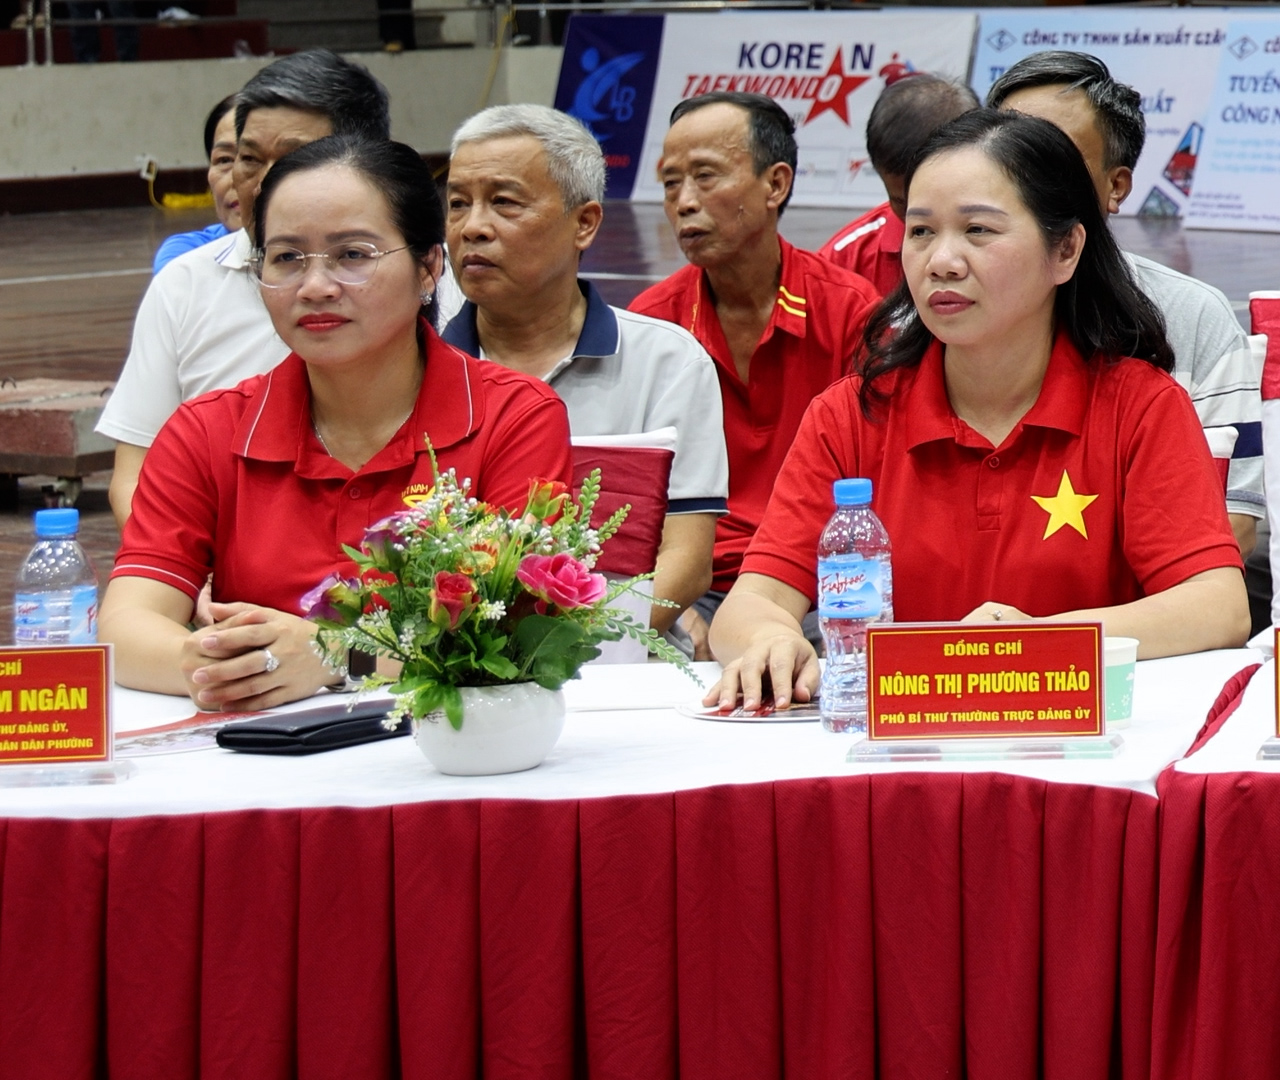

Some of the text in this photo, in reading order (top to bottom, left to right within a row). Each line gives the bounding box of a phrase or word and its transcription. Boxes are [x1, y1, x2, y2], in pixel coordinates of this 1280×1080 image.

[1022, 29, 1057, 45] CÔNG
[1083, 31, 1120, 45] TNHH
[1221, 102, 1269, 123] CÔNG
[944, 639, 1022, 656] ĐỒNG CHÍ
[880, 665, 1090, 698] NÔNG THỊ PHƯƠNG THẢO
[19, 684, 87, 712] NGÂN
[880, 707, 1090, 724] PHÓ BÍ THƯ THƯỜNG TRỰC ĐẢNG ỦY
[18, 722, 50, 734] ĐẢNG
[51, 721, 68, 732] ỦY,
[20, 739, 46, 750] DÂN
[47, 737, 93, 749] PHƯỜNG
